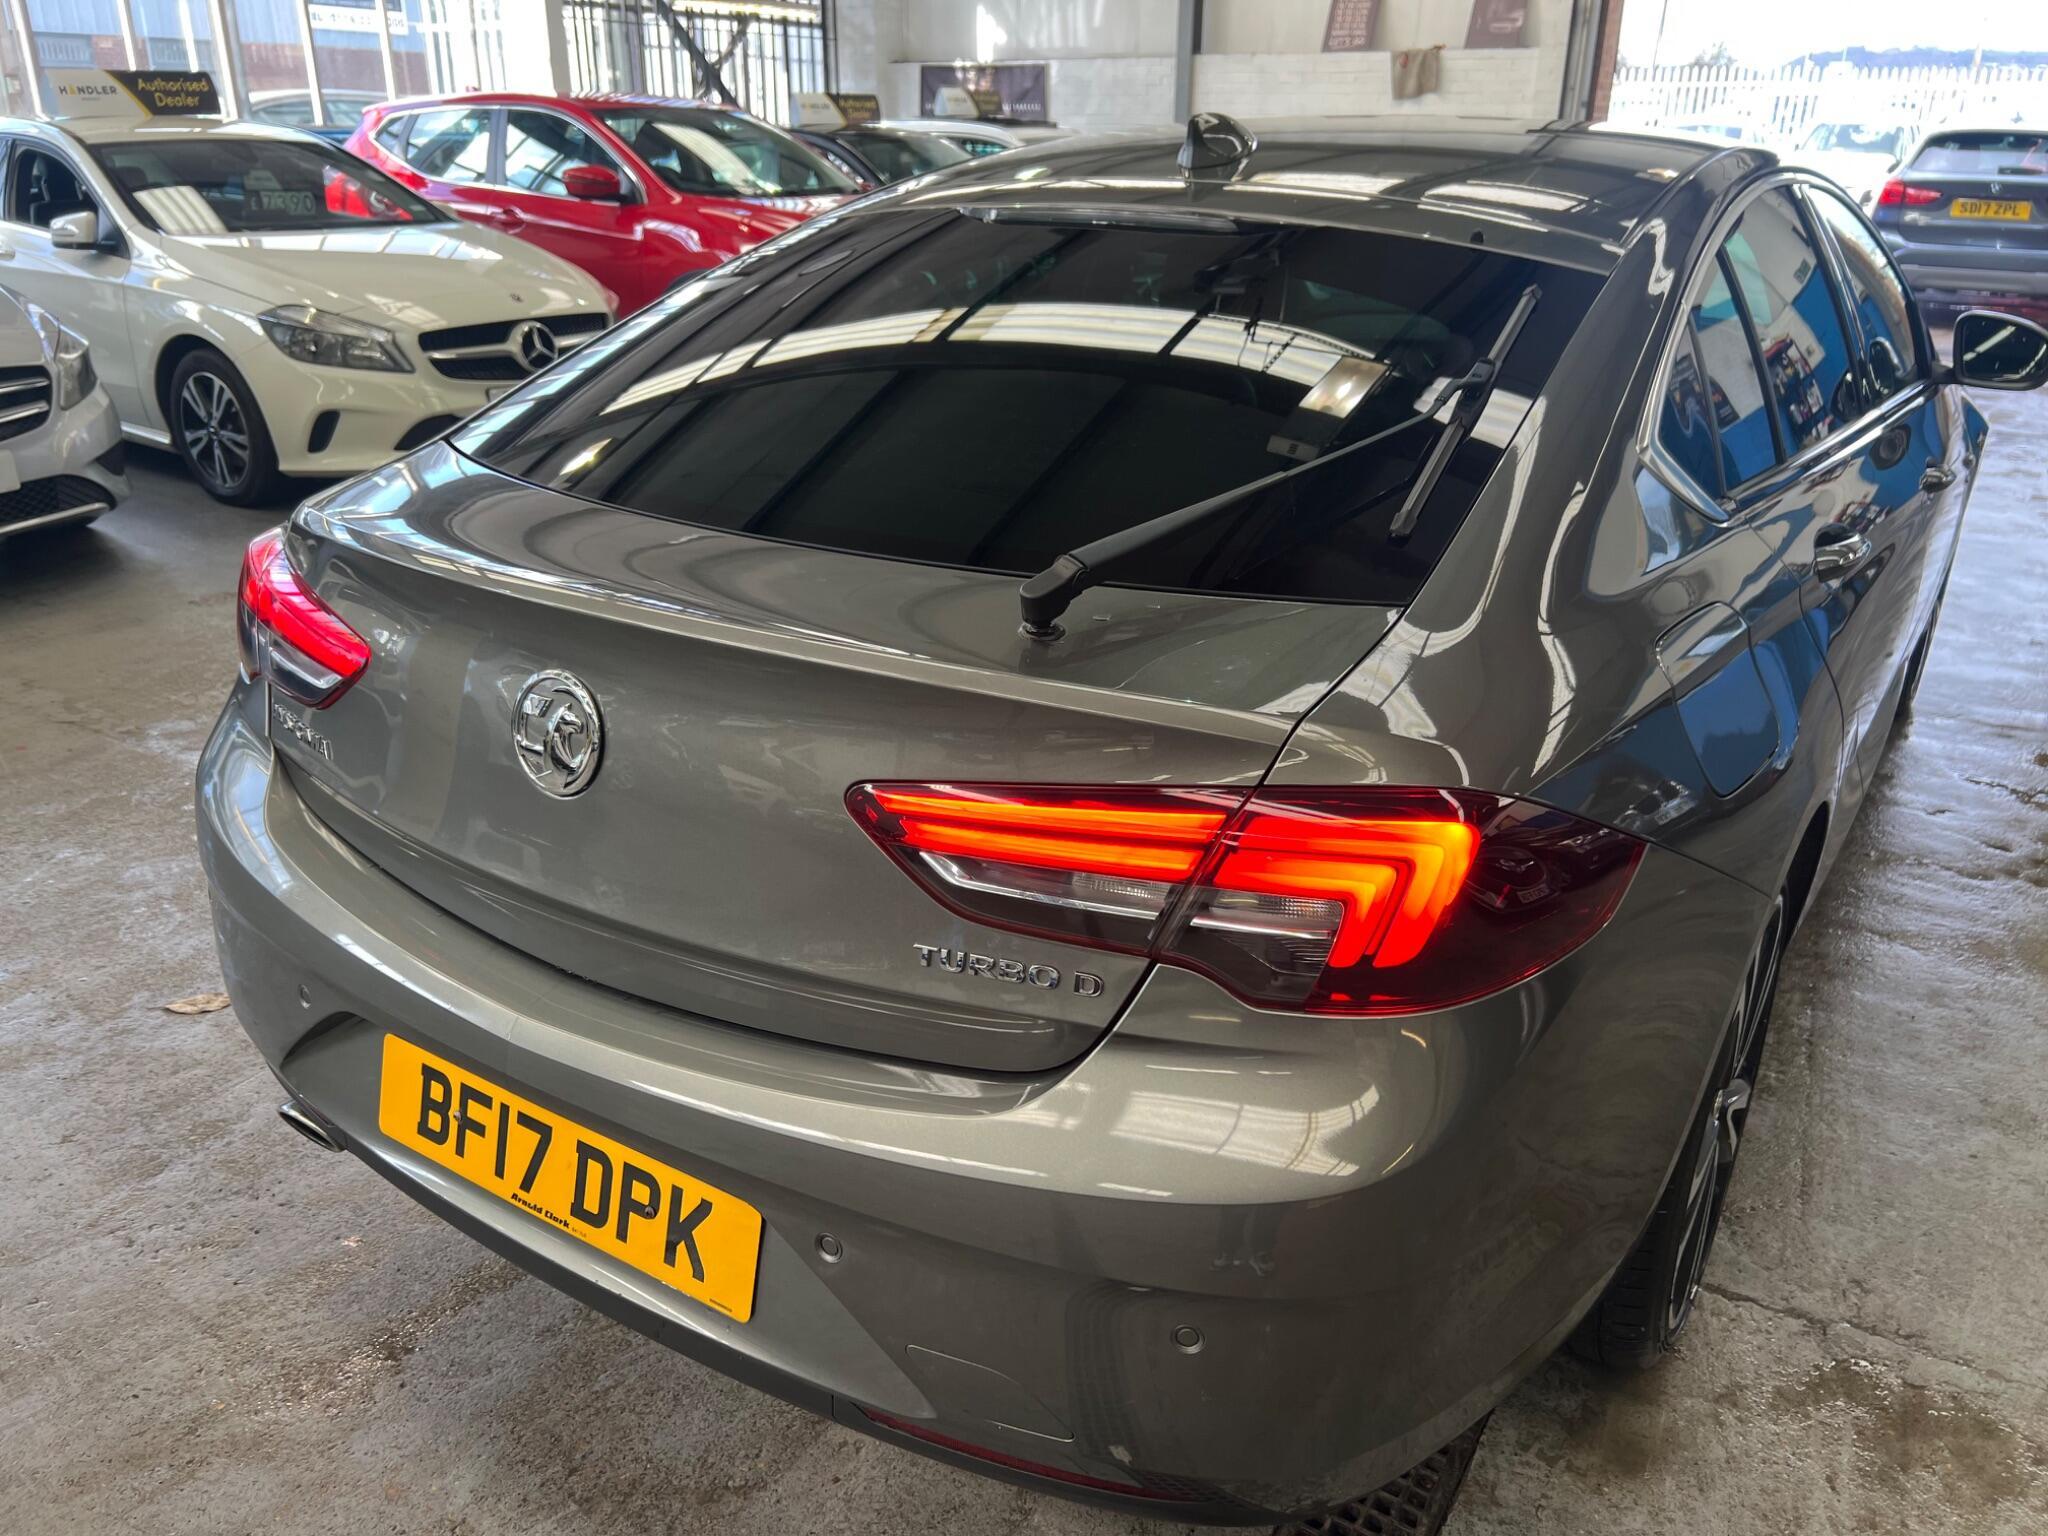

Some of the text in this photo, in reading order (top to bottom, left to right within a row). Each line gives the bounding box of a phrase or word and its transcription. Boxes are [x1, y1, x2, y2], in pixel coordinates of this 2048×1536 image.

[138, 78, 209, 93] Authorised
[155, 94, 200, 108] Dealer
[1960, 201, 2020, 217] SD17 ZPL
[913, 943, 1105, 998] TURBO D
[417, 1063, 713, 1284] BF17 DPK
[511, 1193, 570, 1229] Arnold Clark
